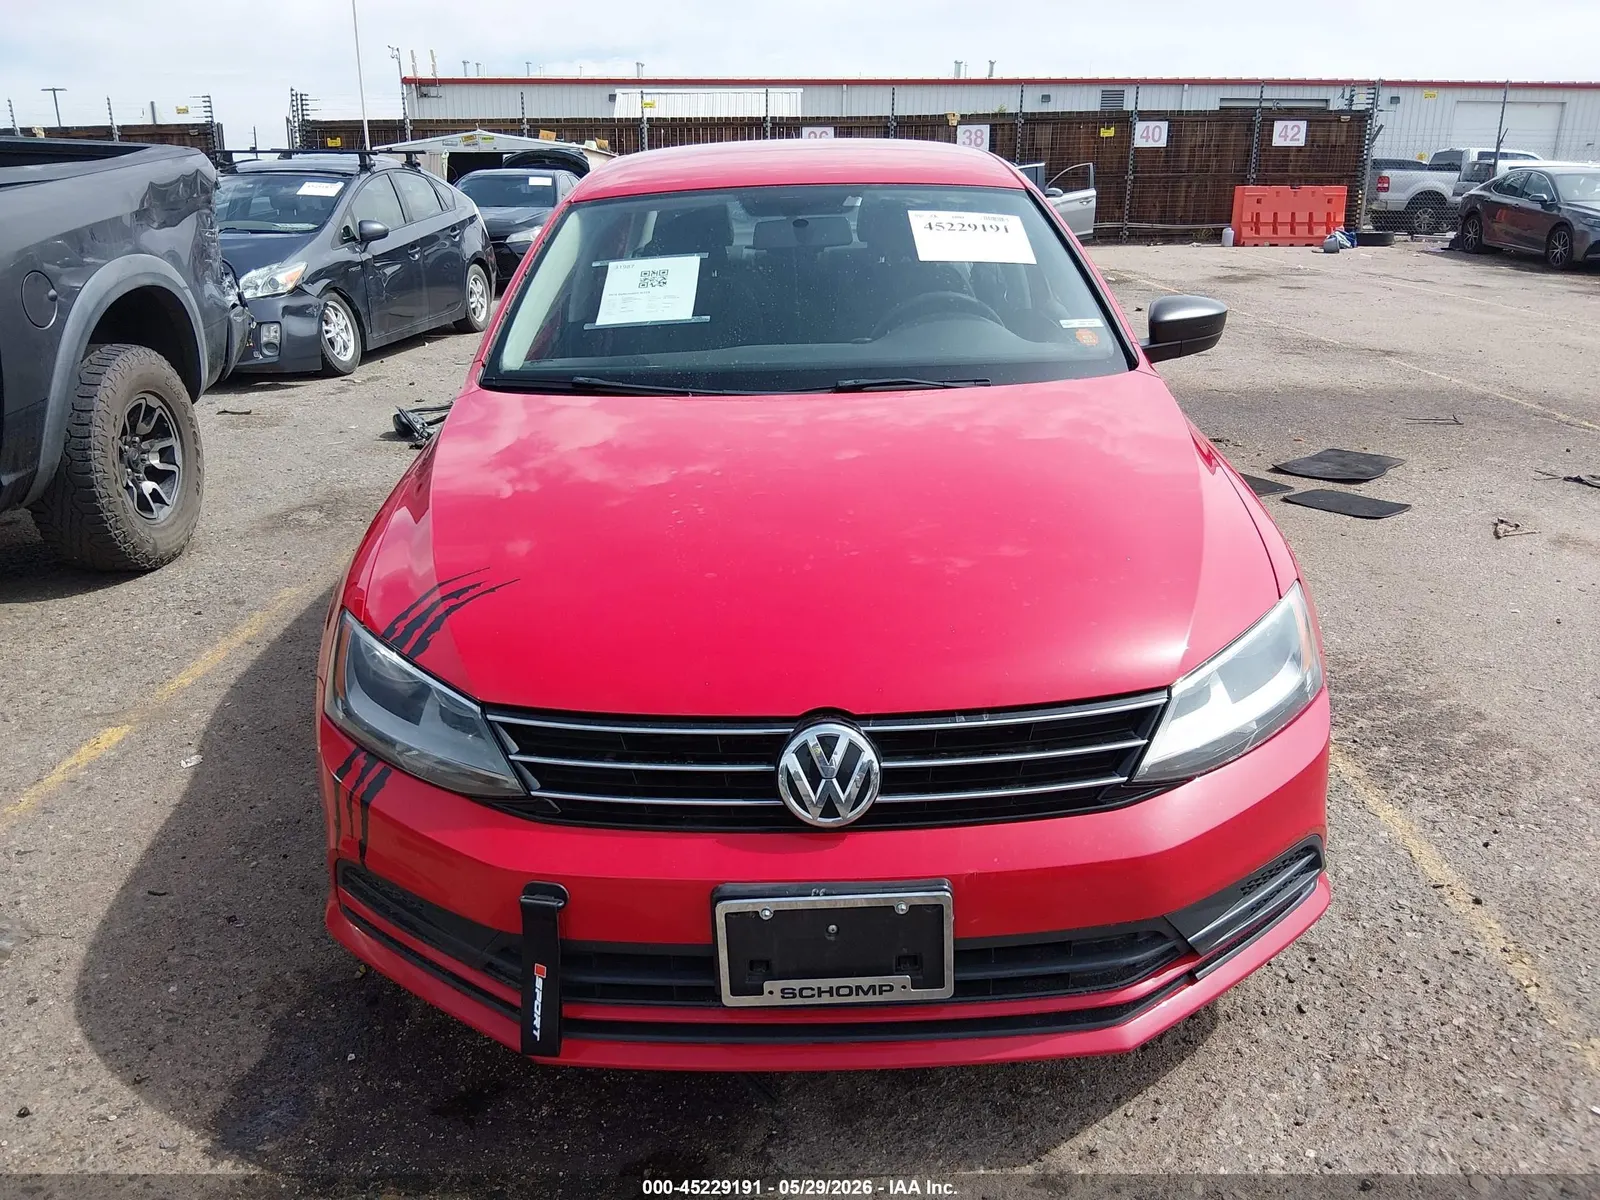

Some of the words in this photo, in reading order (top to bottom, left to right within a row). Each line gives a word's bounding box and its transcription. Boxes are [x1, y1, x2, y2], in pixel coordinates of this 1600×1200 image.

[962, 128, 985, 148] 38
[1140, 125, 1162, 143] 40
[1278, 124, 1300, 142] 42
[923, 221, 1010, 234] 45229191
[779, 723, 879, 826] VW
[780, 983, 895, 1000] SCHOMP
[532, 976, 543, 1042] SPORT
